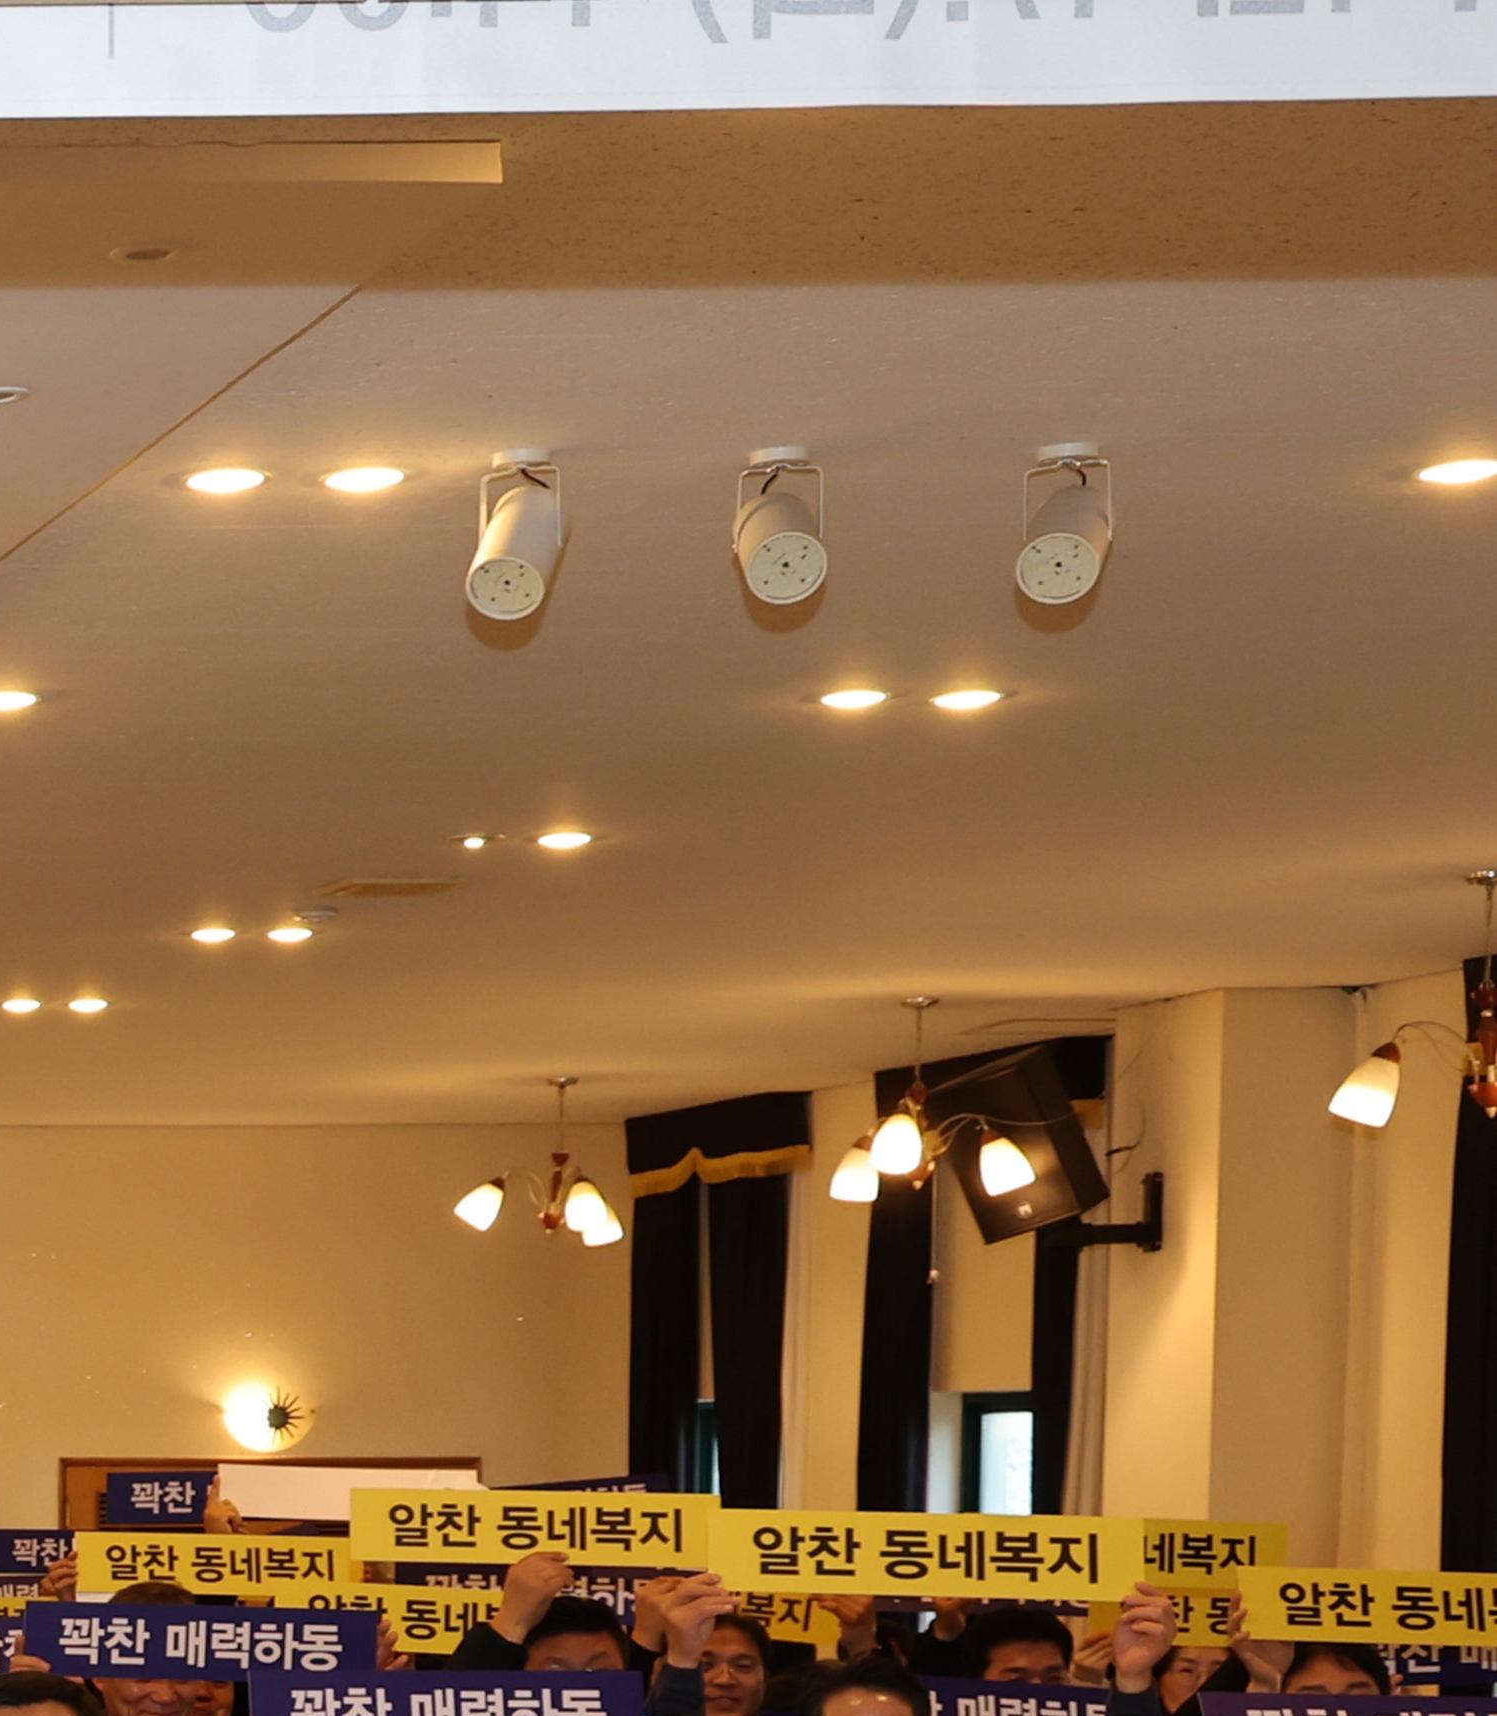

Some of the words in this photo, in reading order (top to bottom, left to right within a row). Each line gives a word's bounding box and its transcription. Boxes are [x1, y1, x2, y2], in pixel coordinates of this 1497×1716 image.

[130, 1481, 196, 1515] 꽉찬
[389, 1503, 481, 1548] 알찬
[496, 1505, 683, 1553] 동네복지
[105, 1544, 179, 1581] 알찬
[190, 1545, 336, 1584] 동네복지
[753, 1525, 862, 1577] 알찬
[879, 1529, 1100, 1584] 동네복지
[1144, 1532, 1257, 1575] 네복지
[1279, 1582, 1375, 1628] 알찬
[1392, 1585, 1497, 1633] 동네
[59, 1617, 151, 1666] 꽉찬
[165, 1619, 344, 1672] 매력하동
